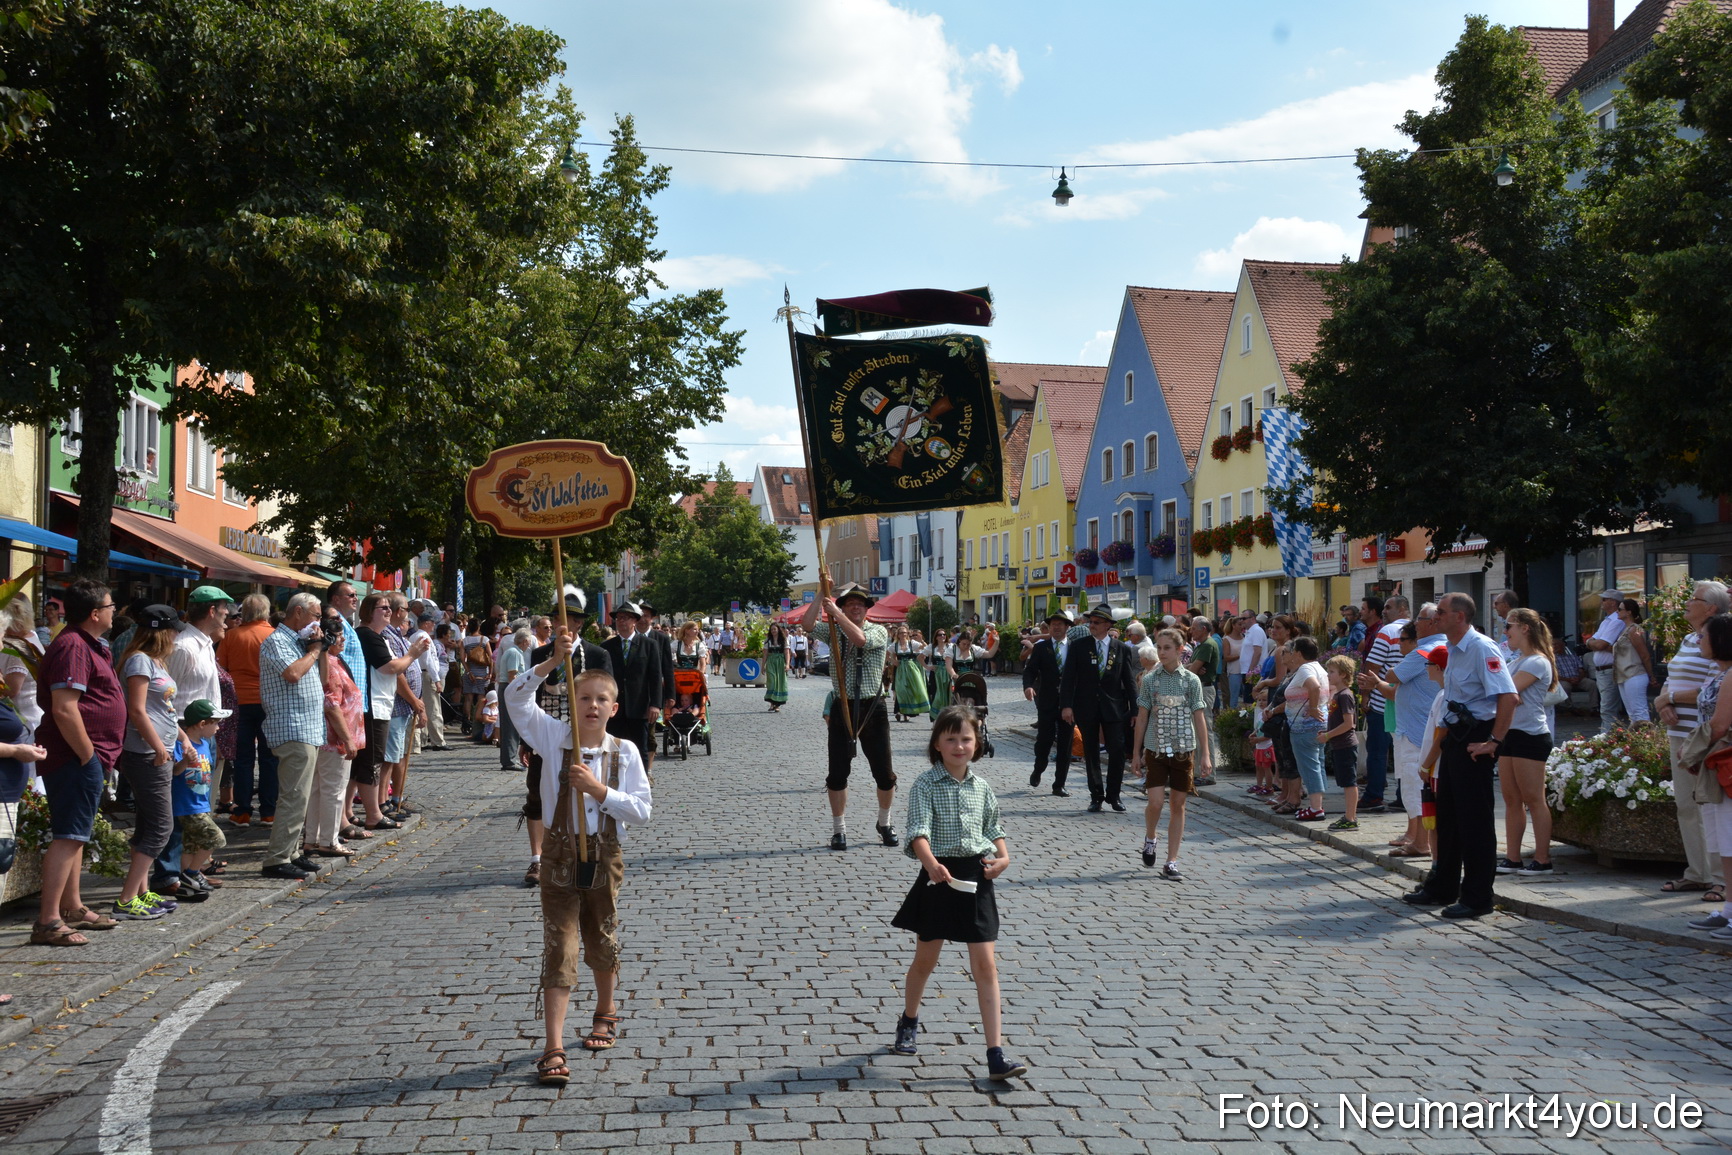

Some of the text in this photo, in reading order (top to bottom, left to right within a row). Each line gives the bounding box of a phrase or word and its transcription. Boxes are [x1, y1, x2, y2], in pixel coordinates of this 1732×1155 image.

[863, 352, 910, 374] Streben
[829, 390, 848, 415] Ziel
[829, 418, 845, 443] Gut
[898, 474, 923, 489] Ein
[921, 463, 948, 485] Ziel
[957, 404, 973, 440] Leben
[551, 471, 609, 508] Wolfstein
[983, 517, 998, 532] HOTEL
[225, 527, 245, 552] LEDER
[871, 579, 885, 592] KL
[1198, 569, 1207, 586] P
